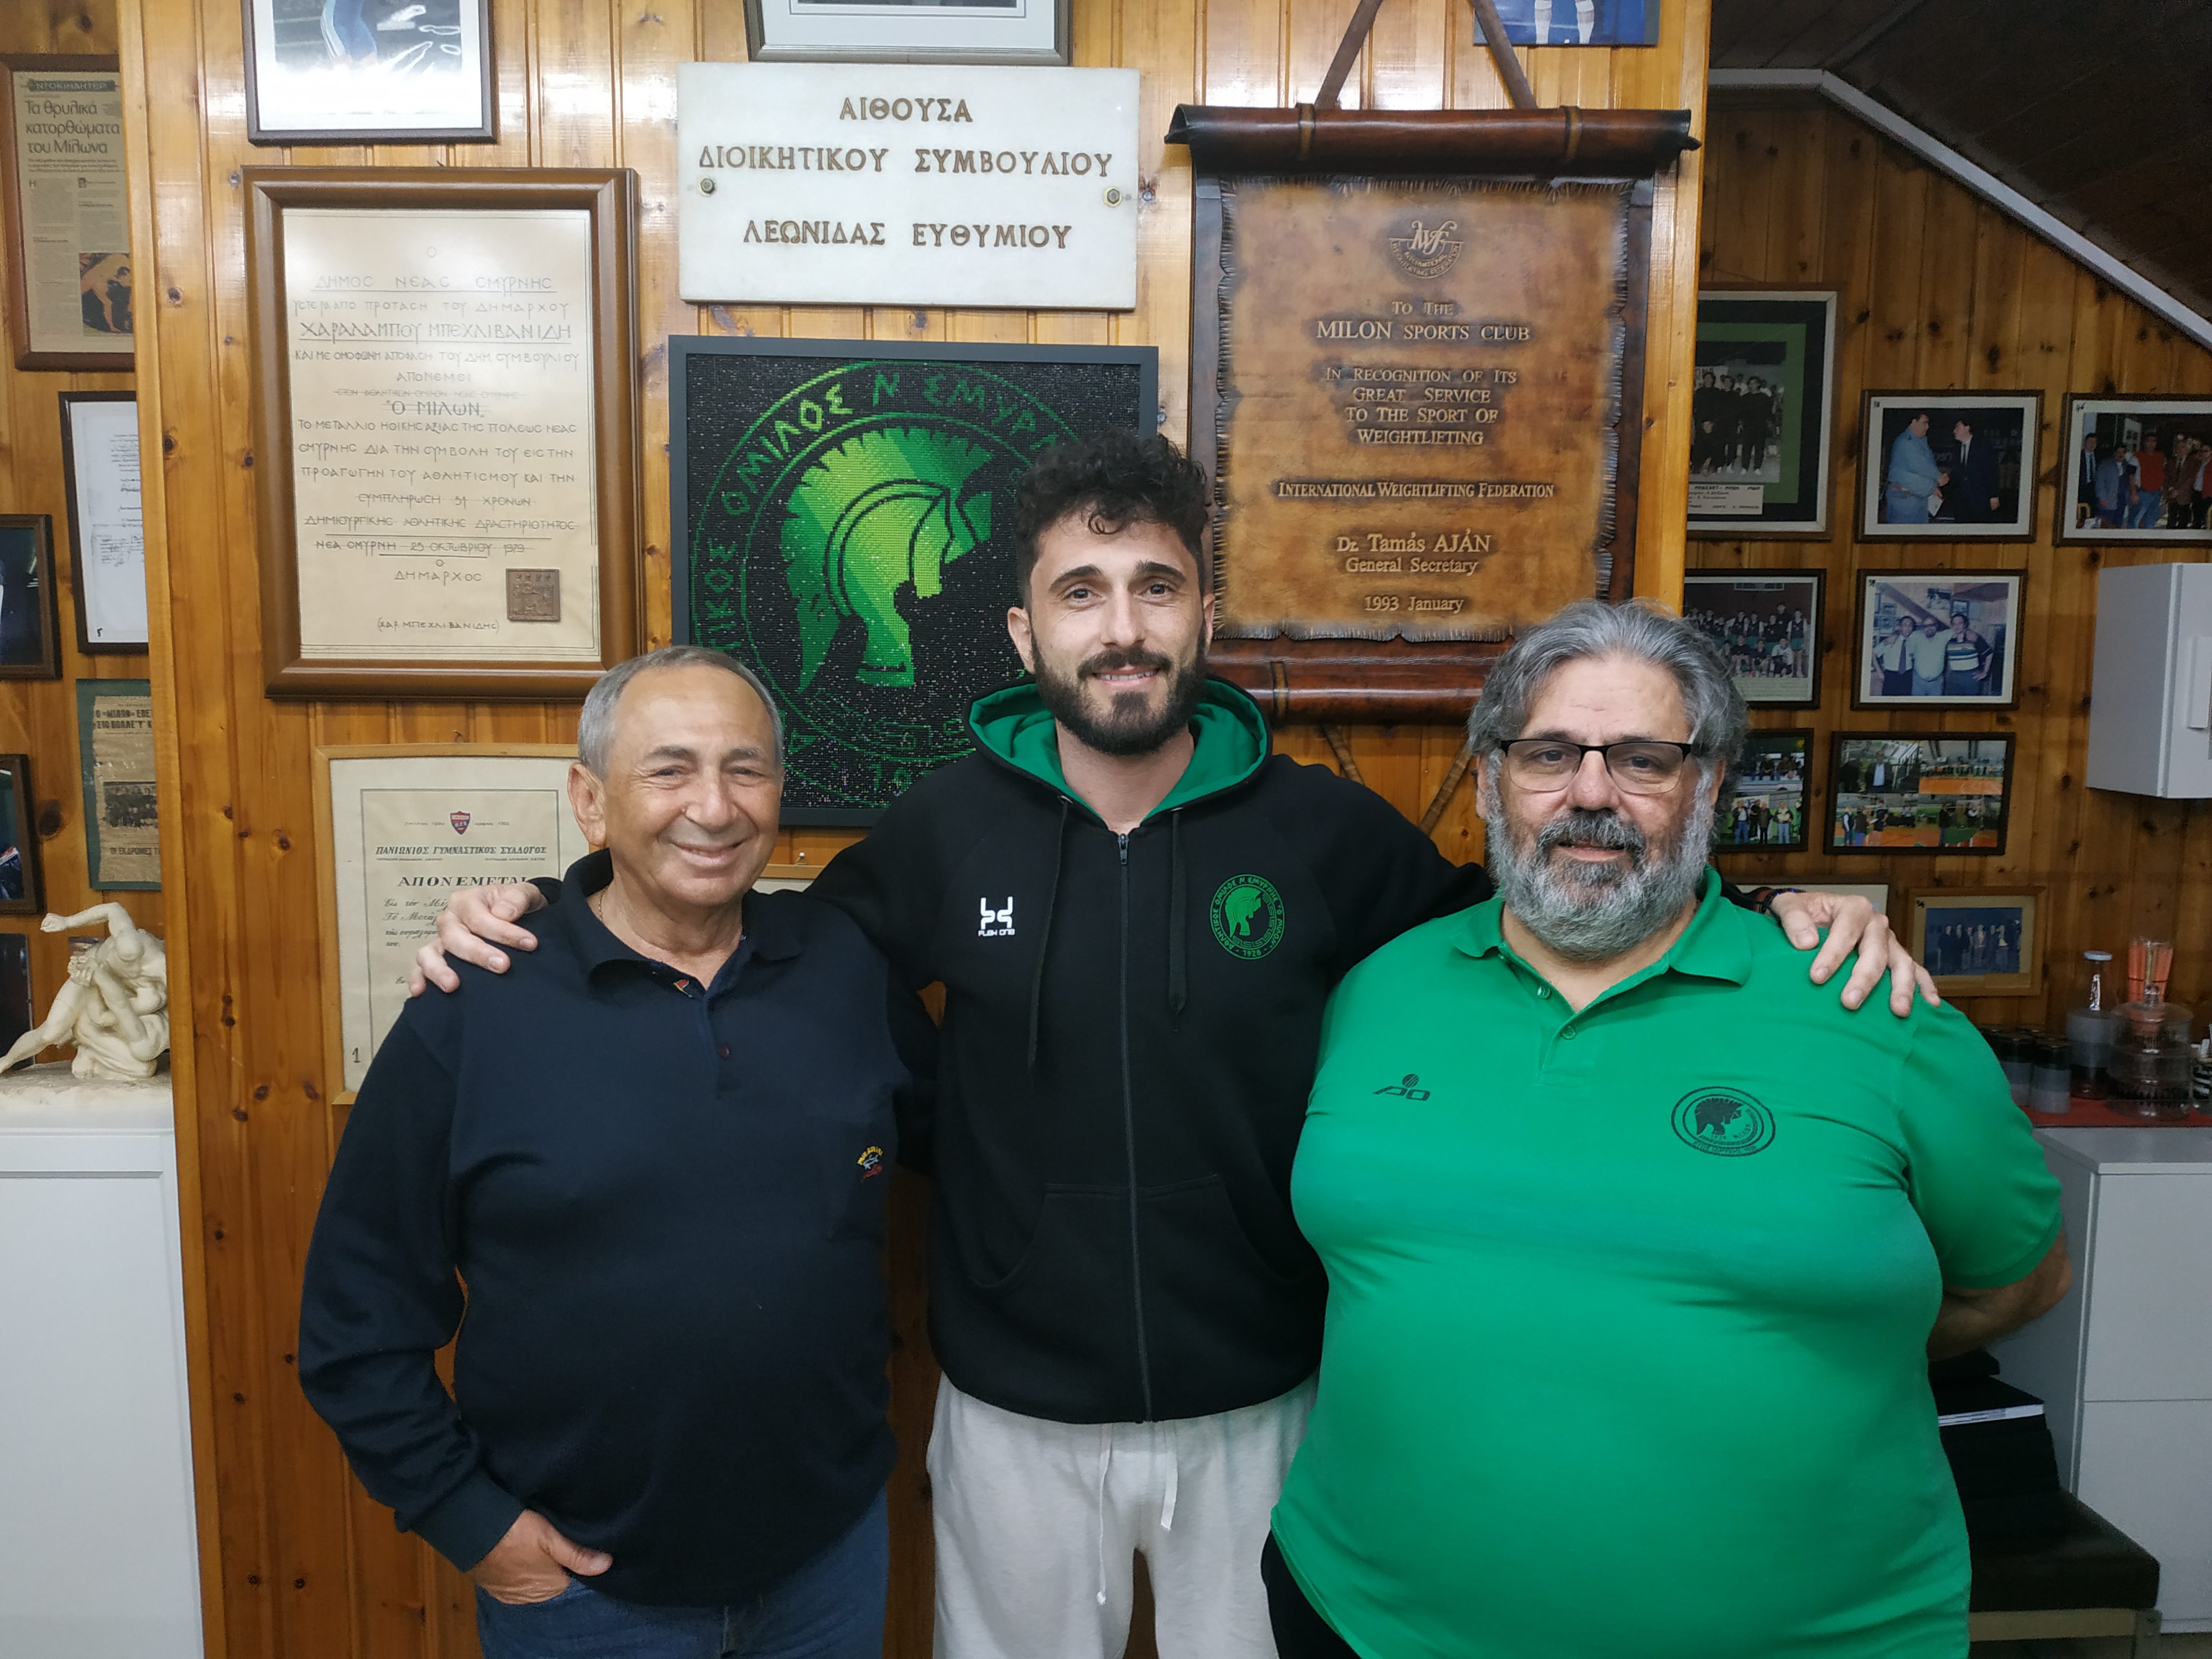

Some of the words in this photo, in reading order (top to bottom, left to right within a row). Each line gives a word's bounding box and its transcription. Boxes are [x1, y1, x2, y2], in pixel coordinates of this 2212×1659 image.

[24, 100, 40, 114] Τα
[44, 100, 97, 119] θρυλικά
[839, 96, 973, 122] ΑΙΘΟΥΣΑ
[26, 119, 119, 138] κατορθώματα
[28, 142, 50, 154] του
[54, 139, 107, 154] Μίλωνα
[698, 145, 889, 172] ΔΙΟΙΚΗΤΙΚΟΥ
[915, 148, 1113, 178] ΣΥΜΒΟΥΛΙΟΥ
[743, 220, 885, 247] ΛΕΩΝΙΔΑΣ
[912, 222, 1072, 250] ΕΥΘΥΜΙΟΥ
[1317, 320, 1392, 339] MILON
[1404, 324, 1470, 340] SPORTS
[1481, 325, 1530, 341] CLUB
[394, 445, 419, 454] ΤΗΝ
[547, 448, 573, 458] ΤΗΝ
[550, 474, 575, 482] ΤΗΝ
[316, 540, 341, 549] ΝΕΑ
[1337, 536, 1359, 552] Dr.
[1367, 532, 1425, 552] Tamás
[1433, 529, 1491, 552] AJÁN
[1345, 557, 1402, 572] General
[1410, 558, 1478, 576] Secretary
[1364, 596, 1400, 611] 1993
[1407, 596, 1464, 613] January
[433, 846, 497, 854] ΓΥΜΝΑΣΤΙΚΟΣ
